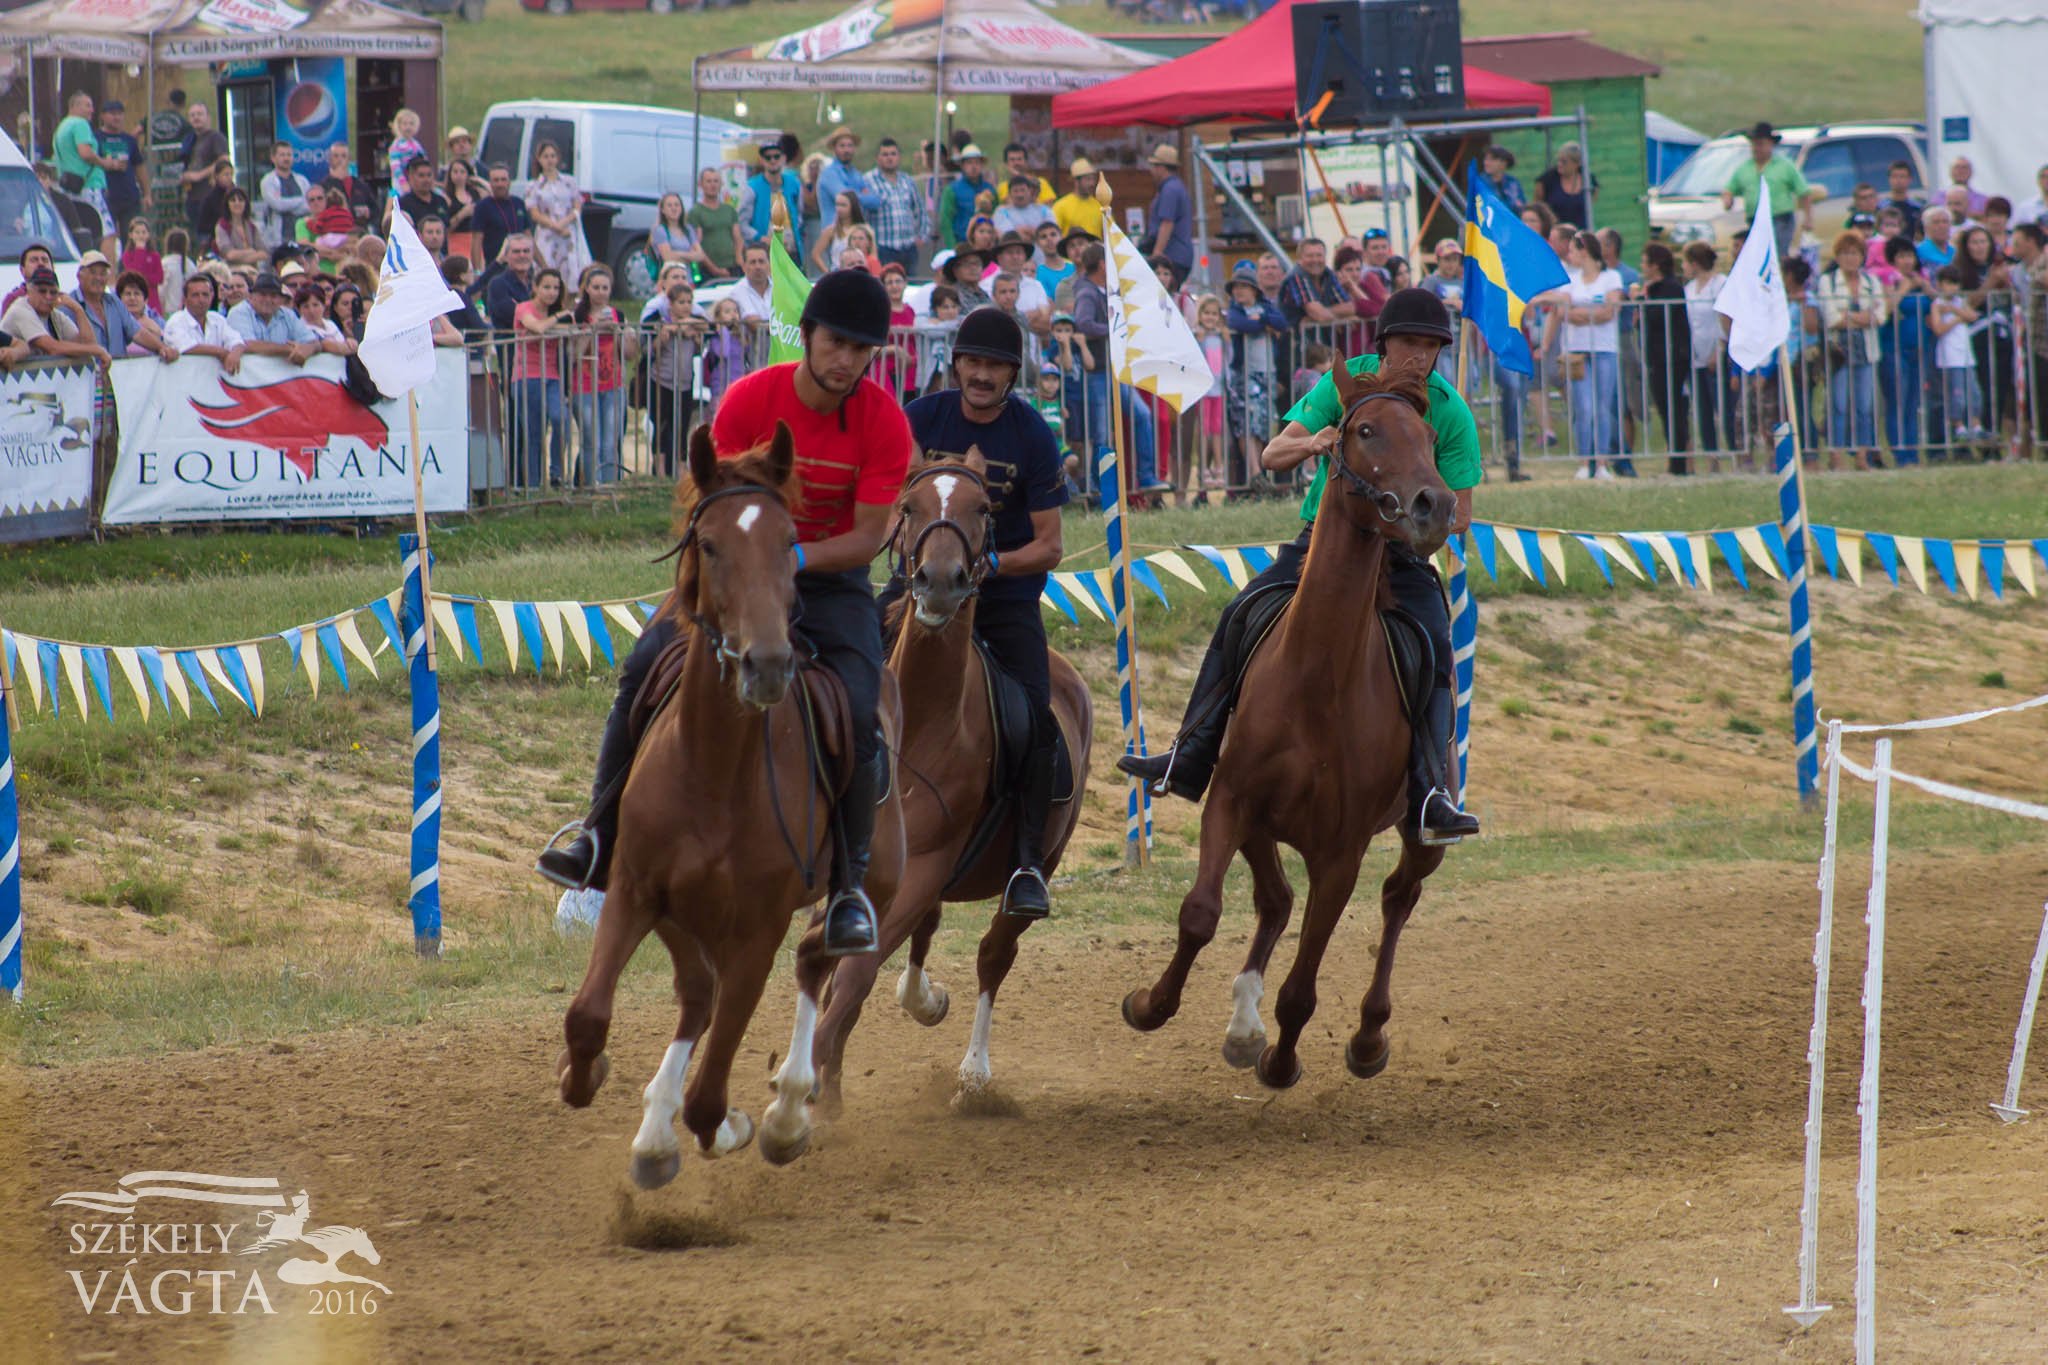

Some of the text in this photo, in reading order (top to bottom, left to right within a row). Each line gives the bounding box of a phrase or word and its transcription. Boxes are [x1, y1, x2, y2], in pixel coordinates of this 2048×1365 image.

[168, 41, 177, 55] A
[277, 33, 373, 53] hagyományos
[953, 69, 966, 86] A
[138, 443, 443, 491] EQUITANA
[226, 494, 262, 504] Lovas
